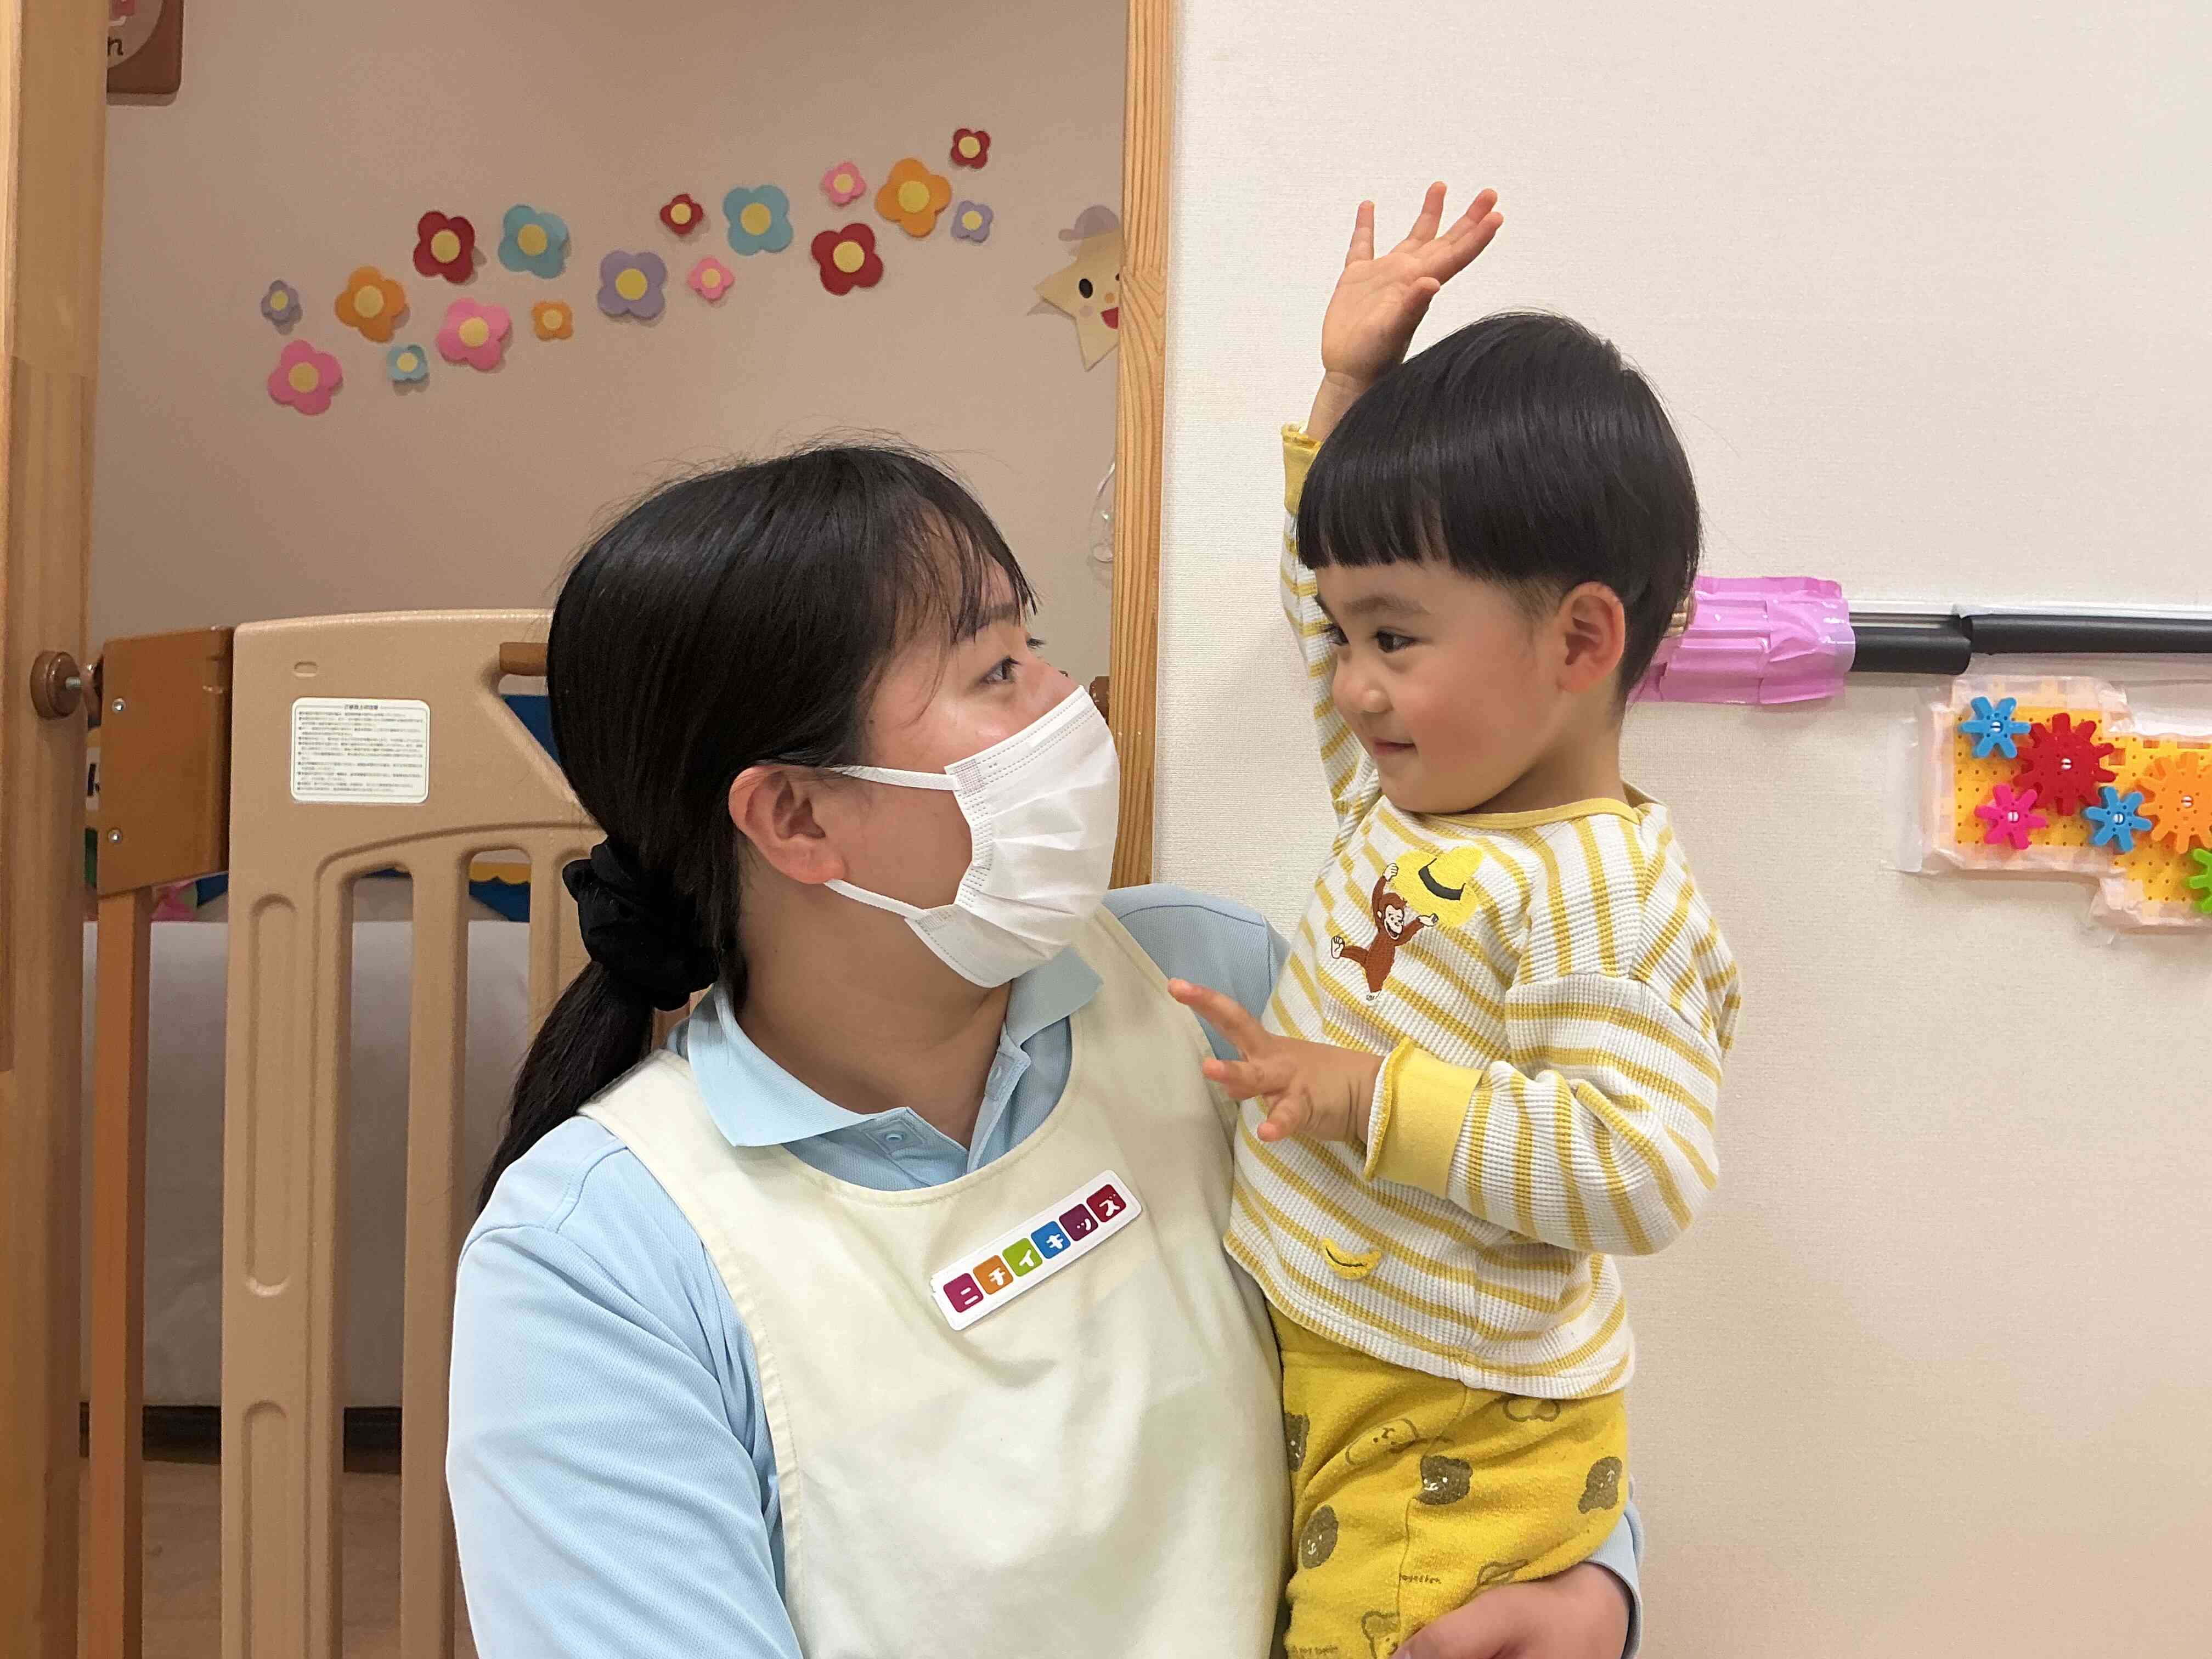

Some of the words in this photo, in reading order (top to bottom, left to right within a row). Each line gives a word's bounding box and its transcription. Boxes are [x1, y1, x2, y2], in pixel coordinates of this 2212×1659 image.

[960, 1193, 1120, 1306] ニチイキッズ
